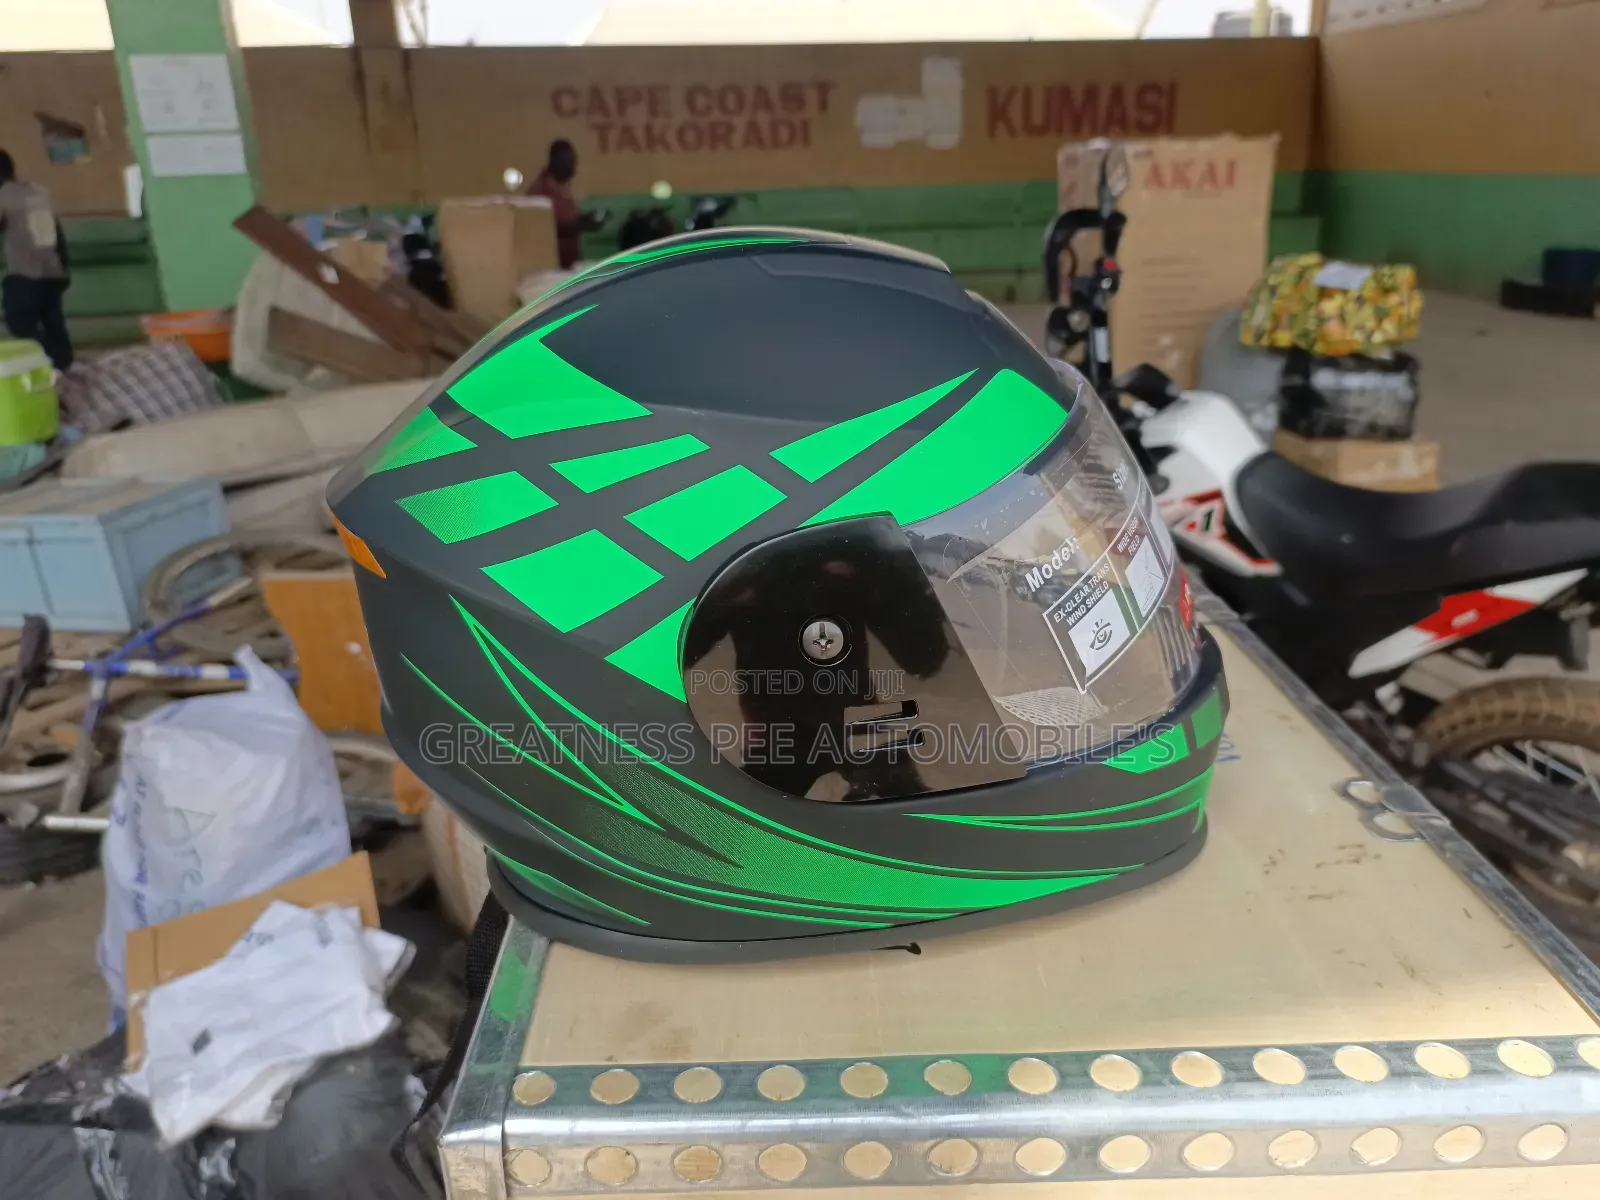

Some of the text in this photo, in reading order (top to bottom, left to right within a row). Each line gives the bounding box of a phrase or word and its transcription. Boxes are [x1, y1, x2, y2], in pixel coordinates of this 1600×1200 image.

[552, 80, 838, 120] CAPE COAST
[986, 82, 1178, 139] KUMASI
[591, 118, 812, 153] TAKORADI
[1145, 159, 1239, 190] AKAI
[1025, 537, 1080, 592] Model:
[1088, 563, 1110, 588] TRANS
[1066, 580, 1109, 626] WIND SHIELD
